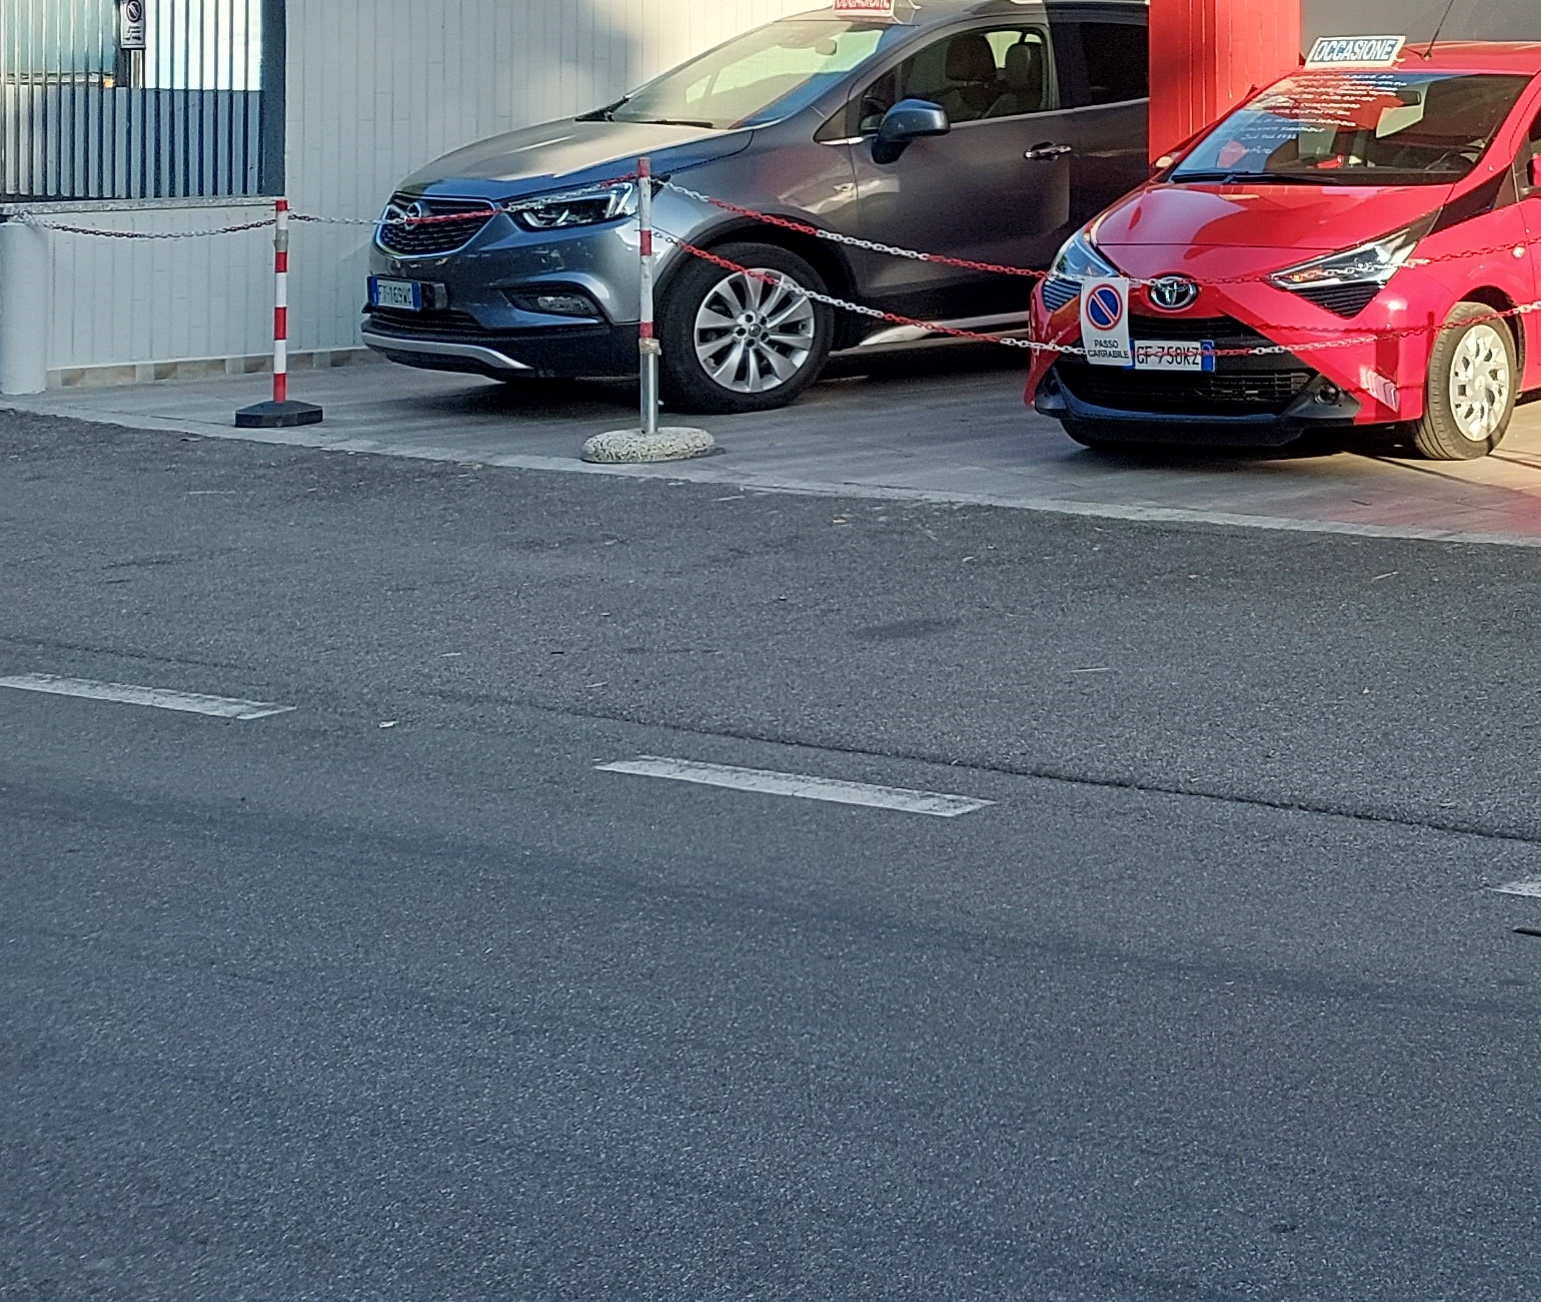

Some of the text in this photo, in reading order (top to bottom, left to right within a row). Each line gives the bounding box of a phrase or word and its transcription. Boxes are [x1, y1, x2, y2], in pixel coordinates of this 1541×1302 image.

[1313, 39, 1396, 62] OCCASIONE
[1094, 339, 1119, 349] PASSO
[1088, 349, 1130, 359] CARRABILE
